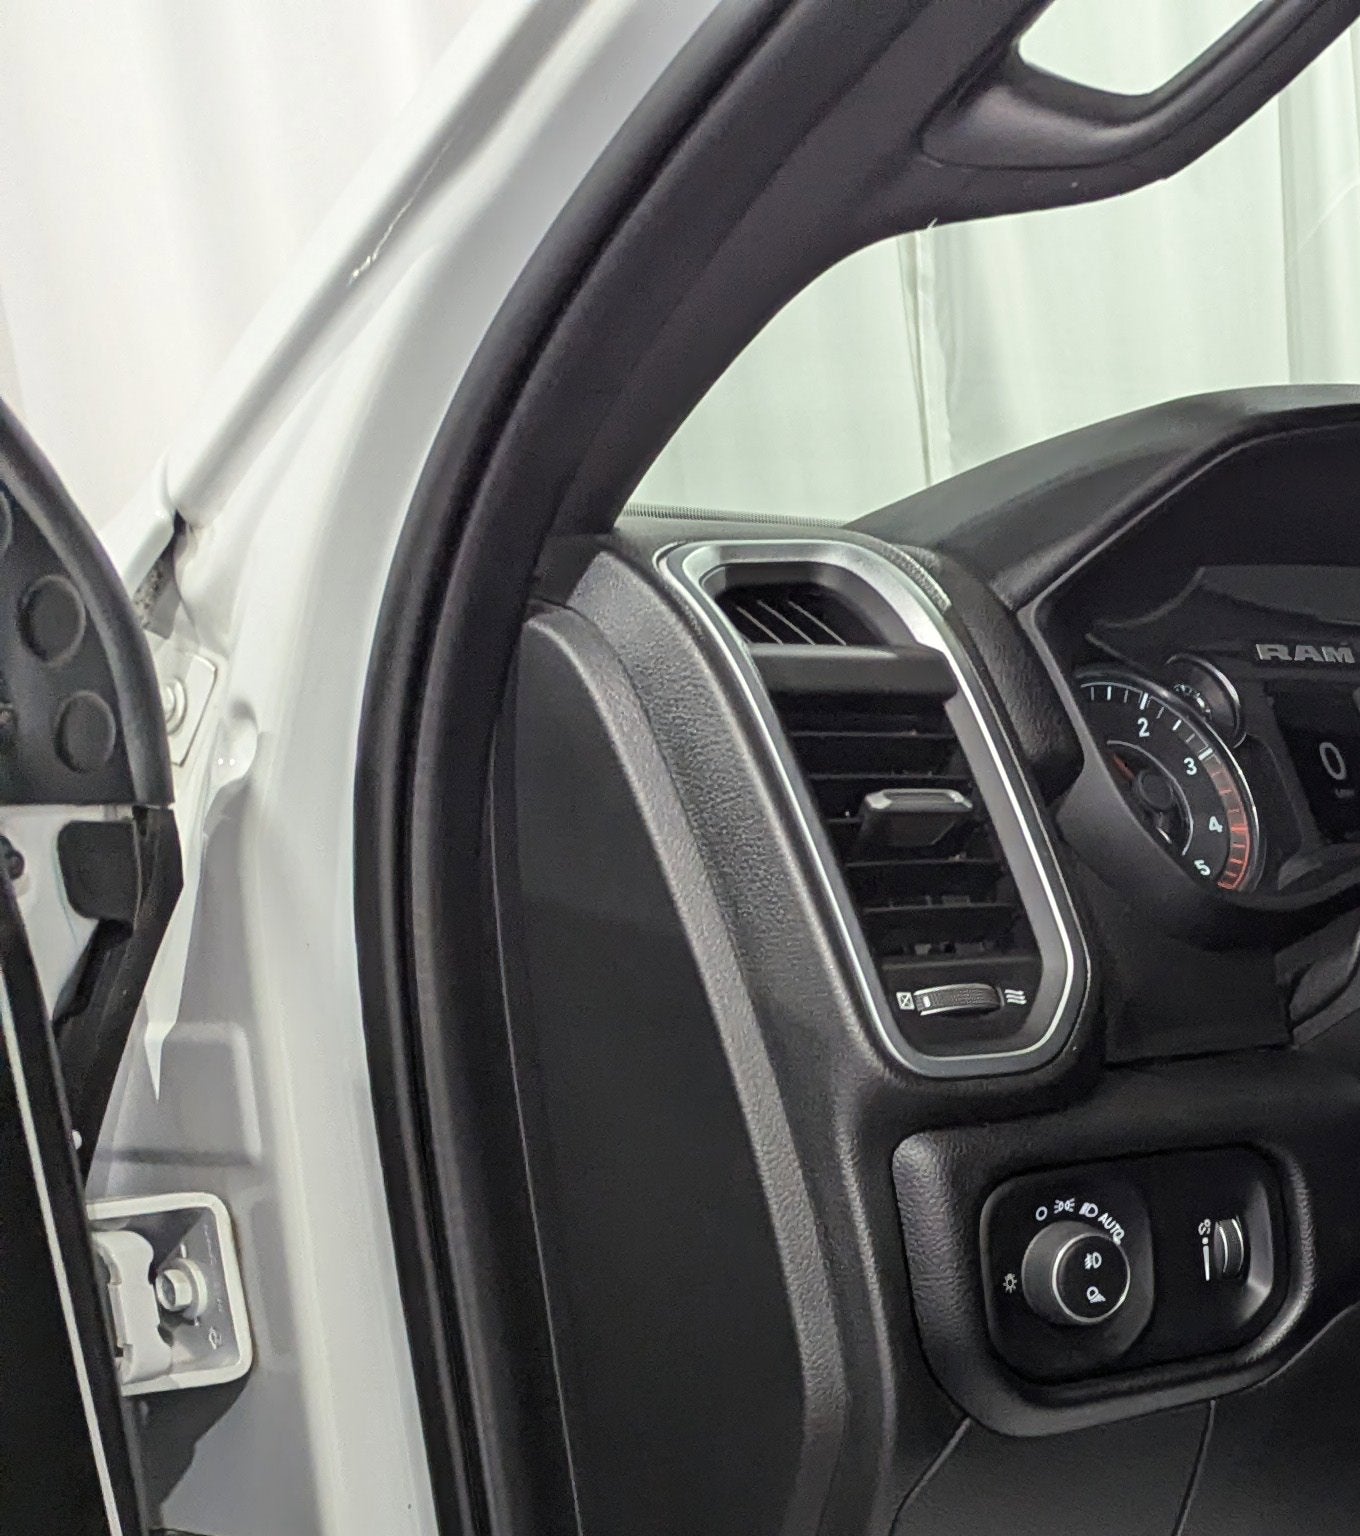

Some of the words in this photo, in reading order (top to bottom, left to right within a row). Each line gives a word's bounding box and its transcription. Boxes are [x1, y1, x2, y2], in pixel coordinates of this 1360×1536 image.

[1255, 643, 1356, 664] RAM
[1137, 717, 1150, 737] 2
[1183, 757, 1197, 775] 3
[1208, 815, 1223, 833] 4
[1193, 859, 1211, 876] 5
[1097, 1212, 1125, 1243] AUTO
